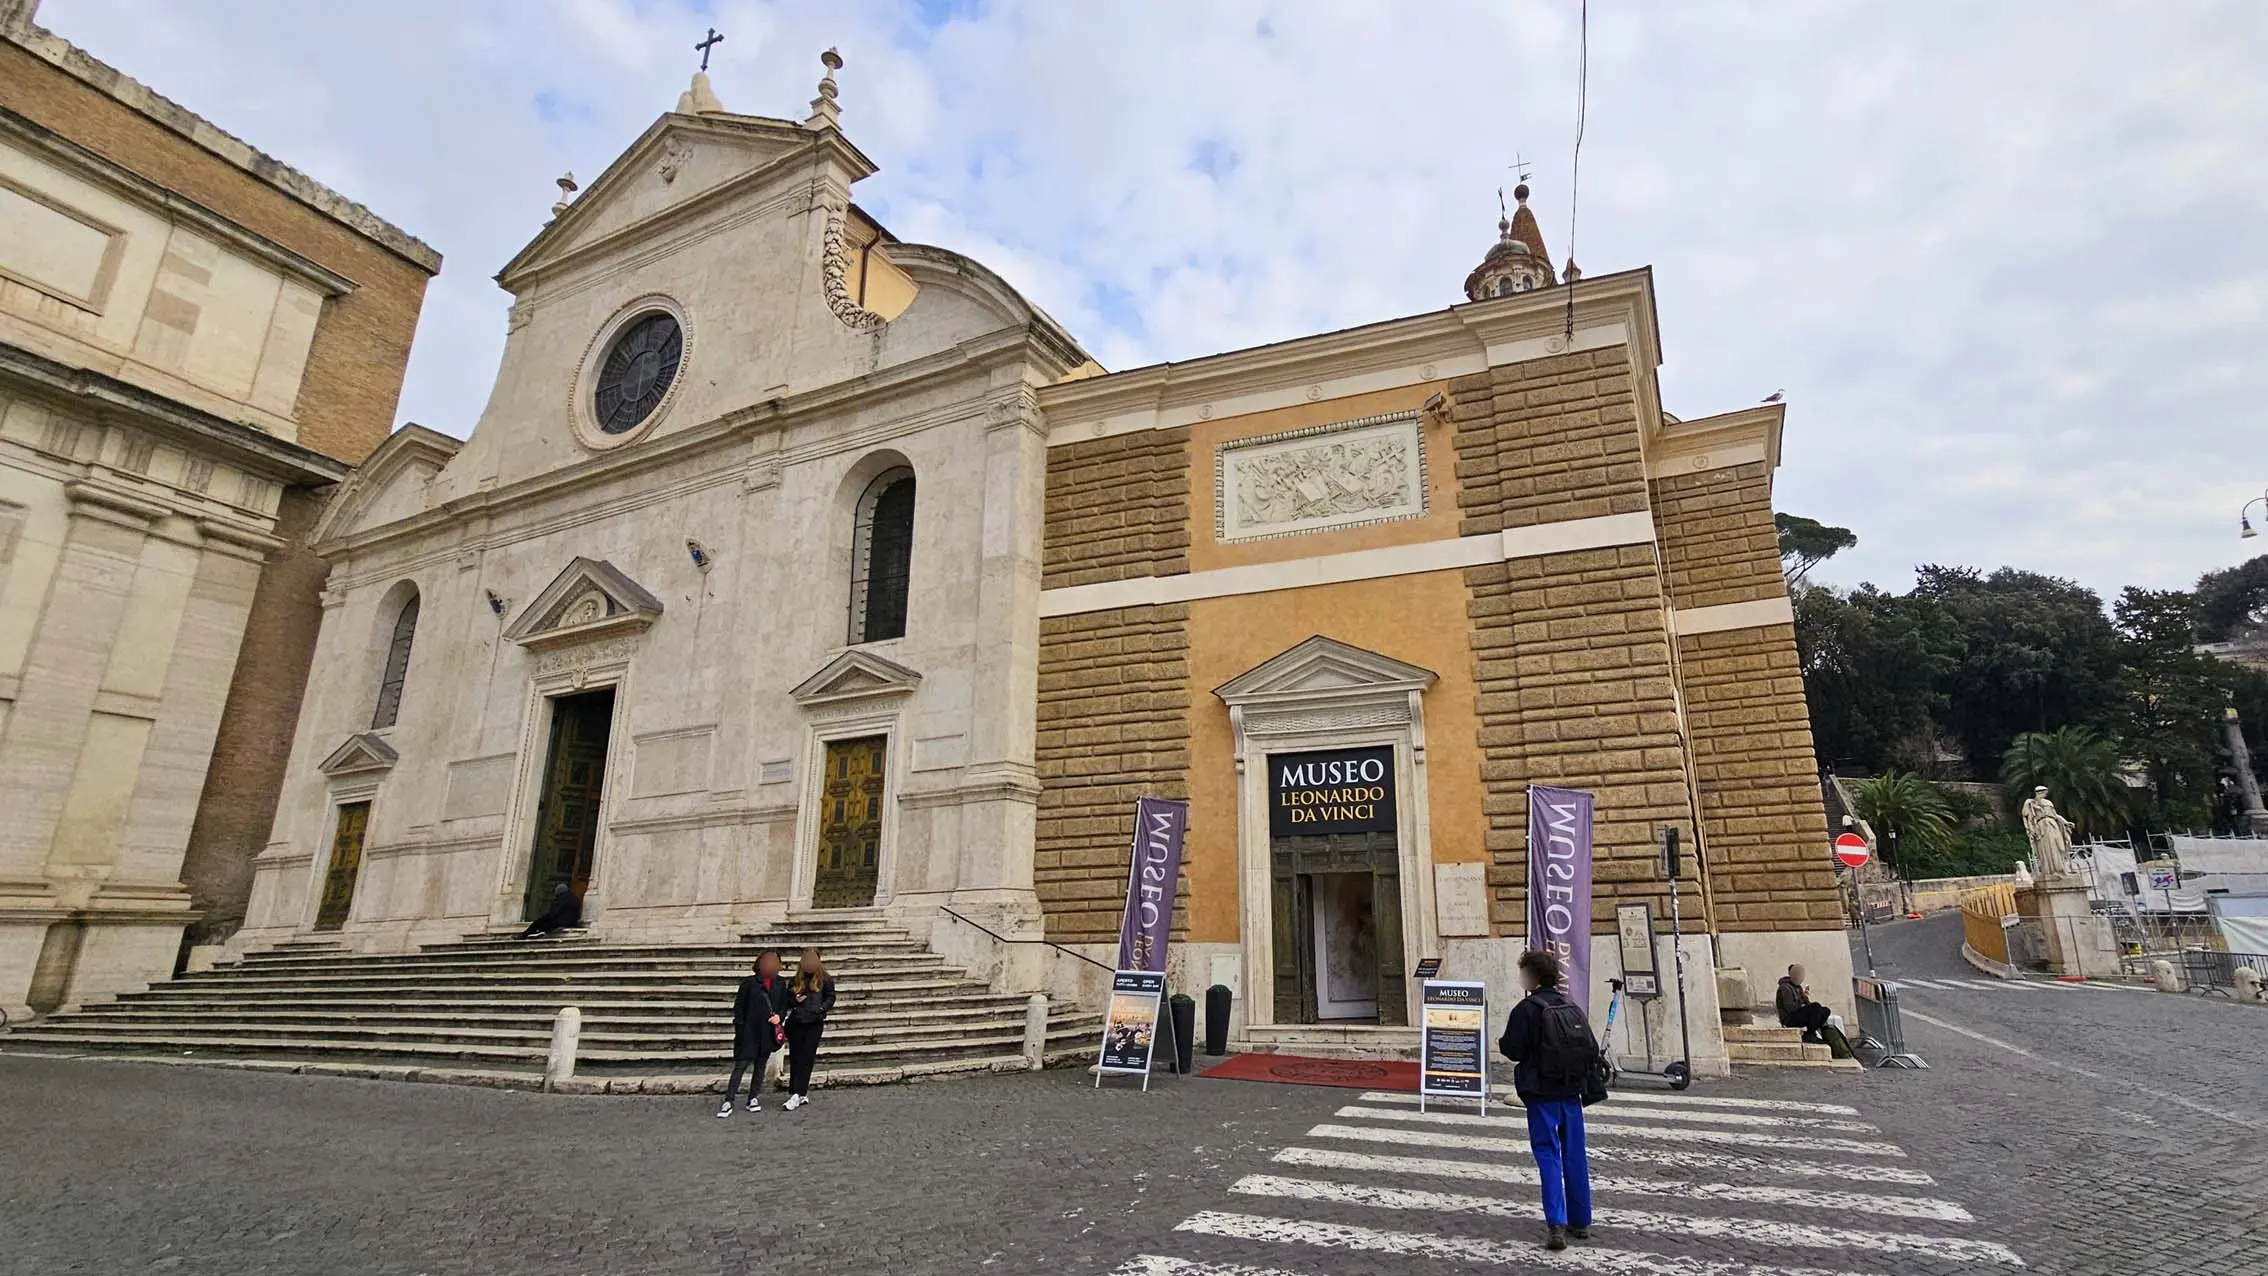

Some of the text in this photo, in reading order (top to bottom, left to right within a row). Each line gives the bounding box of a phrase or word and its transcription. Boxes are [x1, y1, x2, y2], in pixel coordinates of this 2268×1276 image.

[1280, 758, 1384, 788] MUSEO
[1281, 786, 1385, 806] LEONARDO
[1291, 804, 1375, 823] DA VINCI
